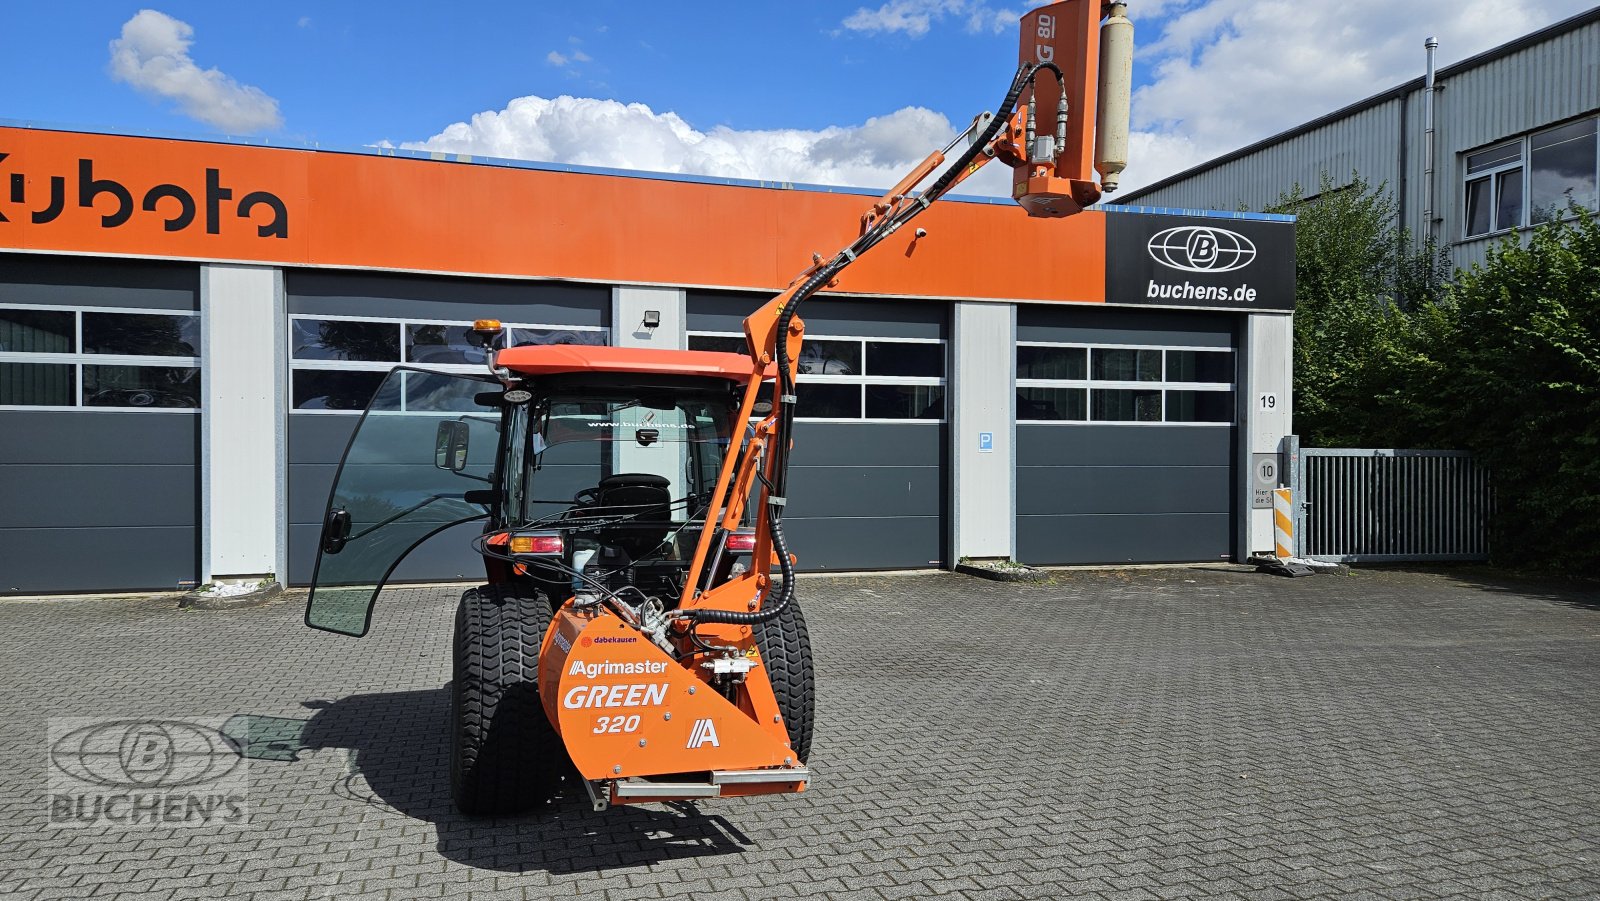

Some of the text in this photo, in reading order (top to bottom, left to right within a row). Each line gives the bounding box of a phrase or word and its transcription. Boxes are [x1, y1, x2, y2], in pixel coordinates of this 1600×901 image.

[1038, 14, 1051, 38] 80
[1147, 280, 1257, 301] buchens.de
[1260, 395, 1276, 408] 19
[980, 434, 991, 448] P
[1262, 465, 1273, 477] 10
[569, 660, 667, 679] Agrimaster
[564, 684, 669, 708] GREEN
[593, 715, 640, 733] 320
